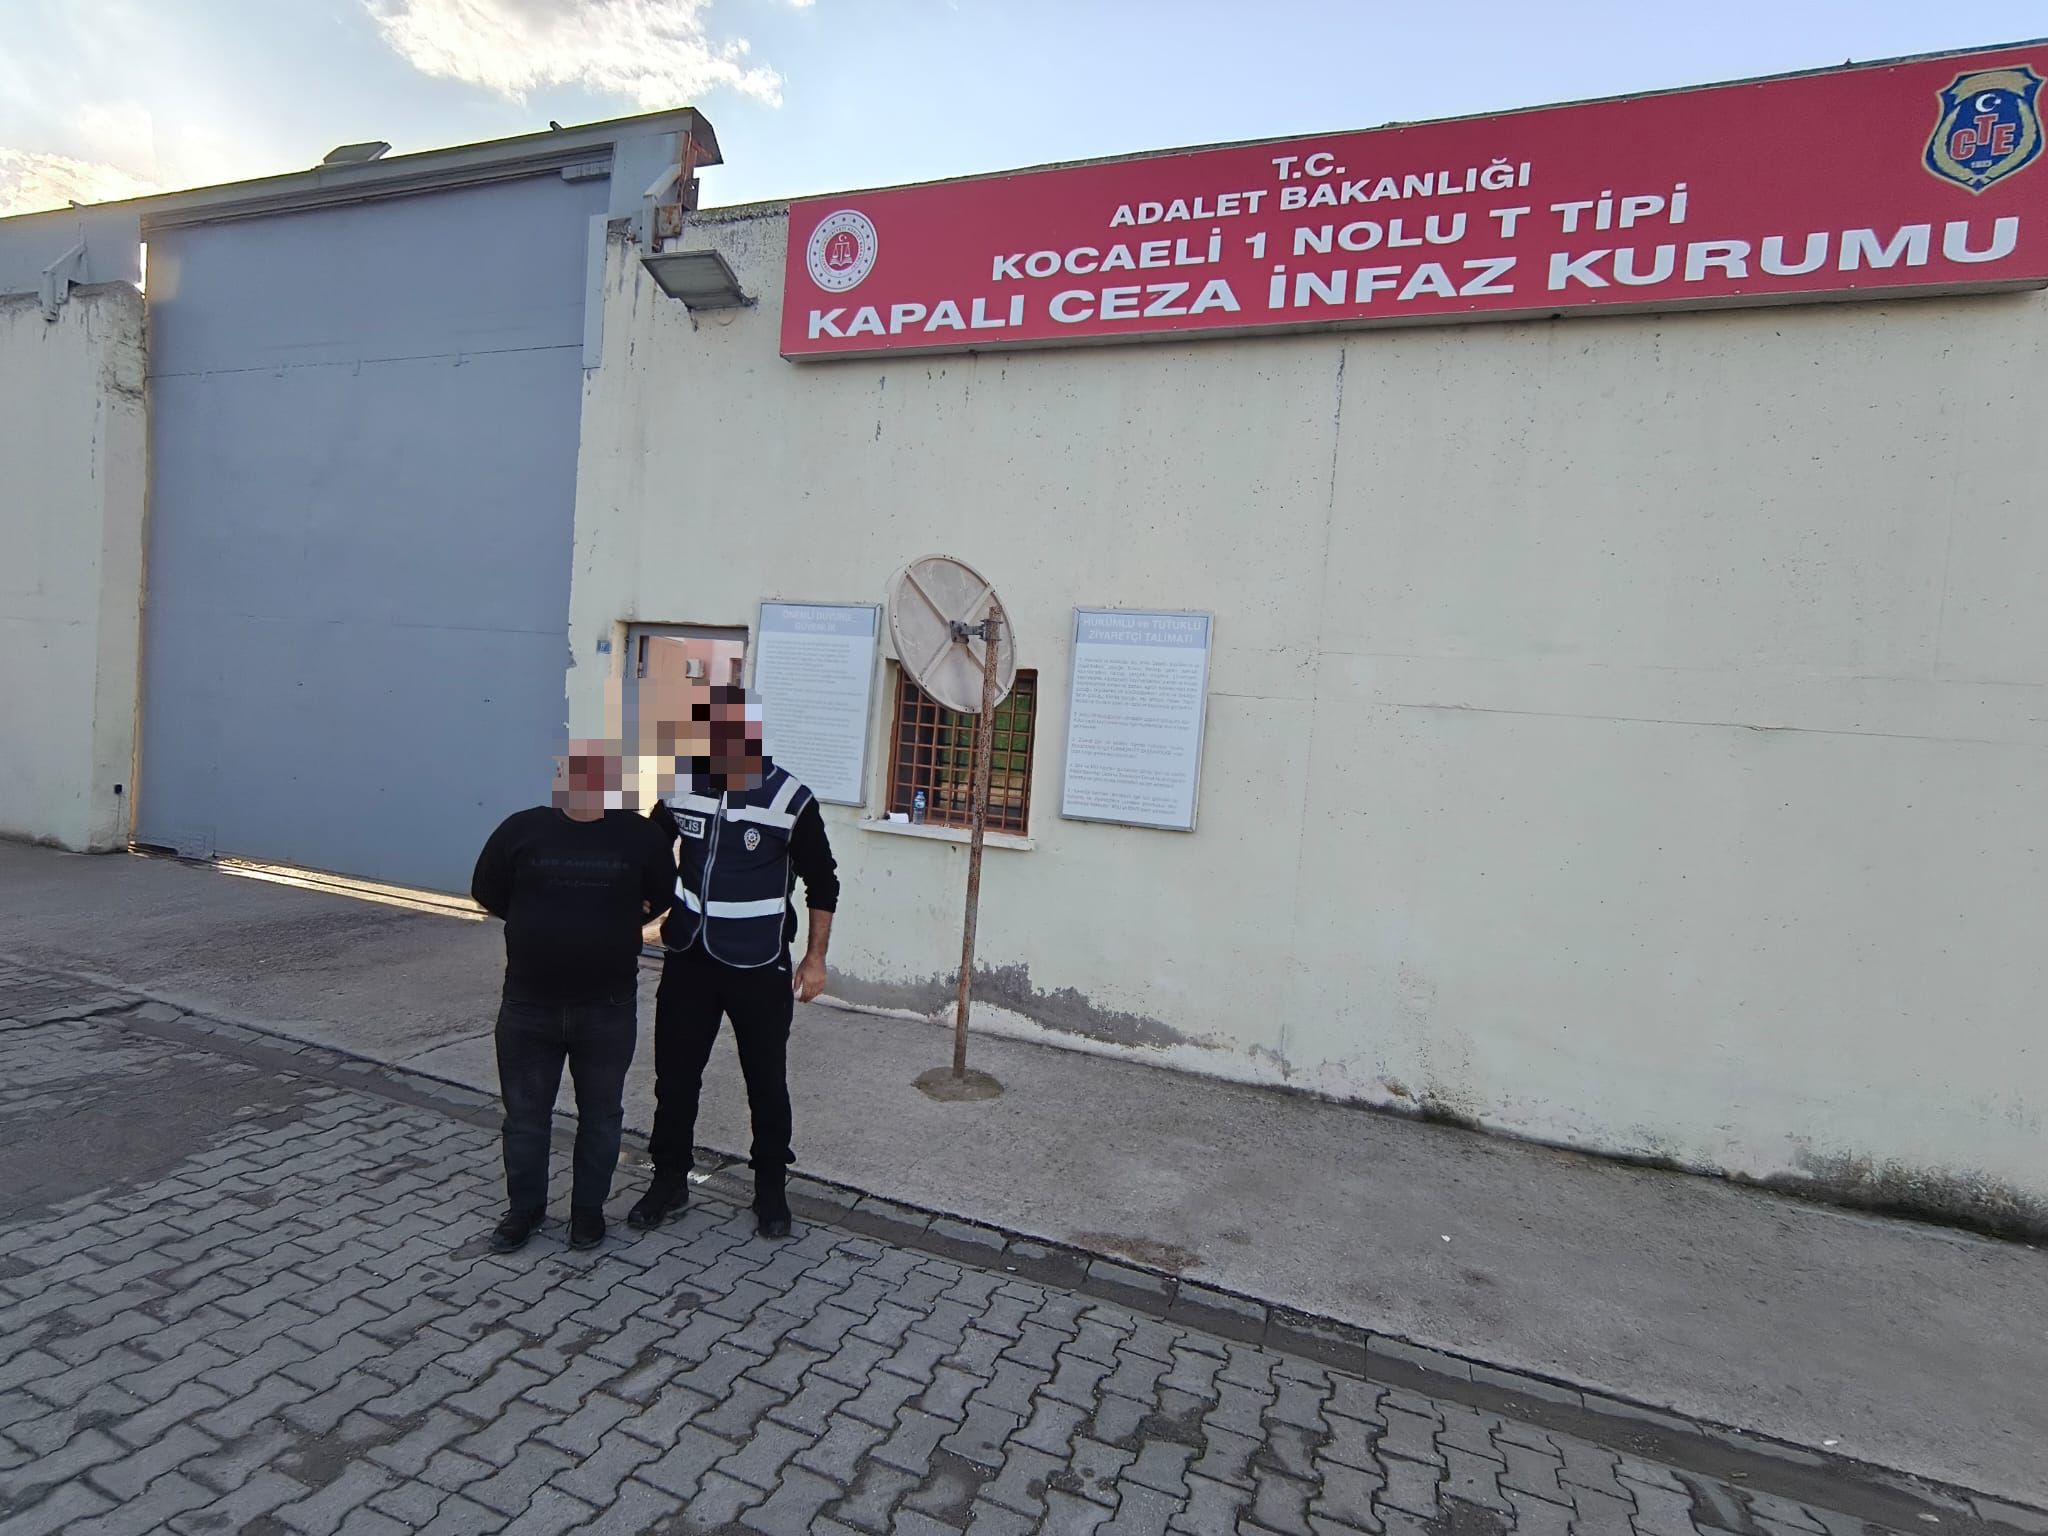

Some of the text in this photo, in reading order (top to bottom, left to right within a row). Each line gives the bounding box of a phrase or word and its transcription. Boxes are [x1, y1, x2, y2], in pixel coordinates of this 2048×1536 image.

[1272, 152, 1346, 182] T.C.
[1950, 113, 2017, 161] CTE
[1109, 157, 1531, 229] ADALET BAKANLIĞI
[992, 182, 1689, 281] KOCAELİ 1 NOLU T TİPİ
[808, 216, 2019, 339] KAPALI CEZA İNFAZ KURUMU
